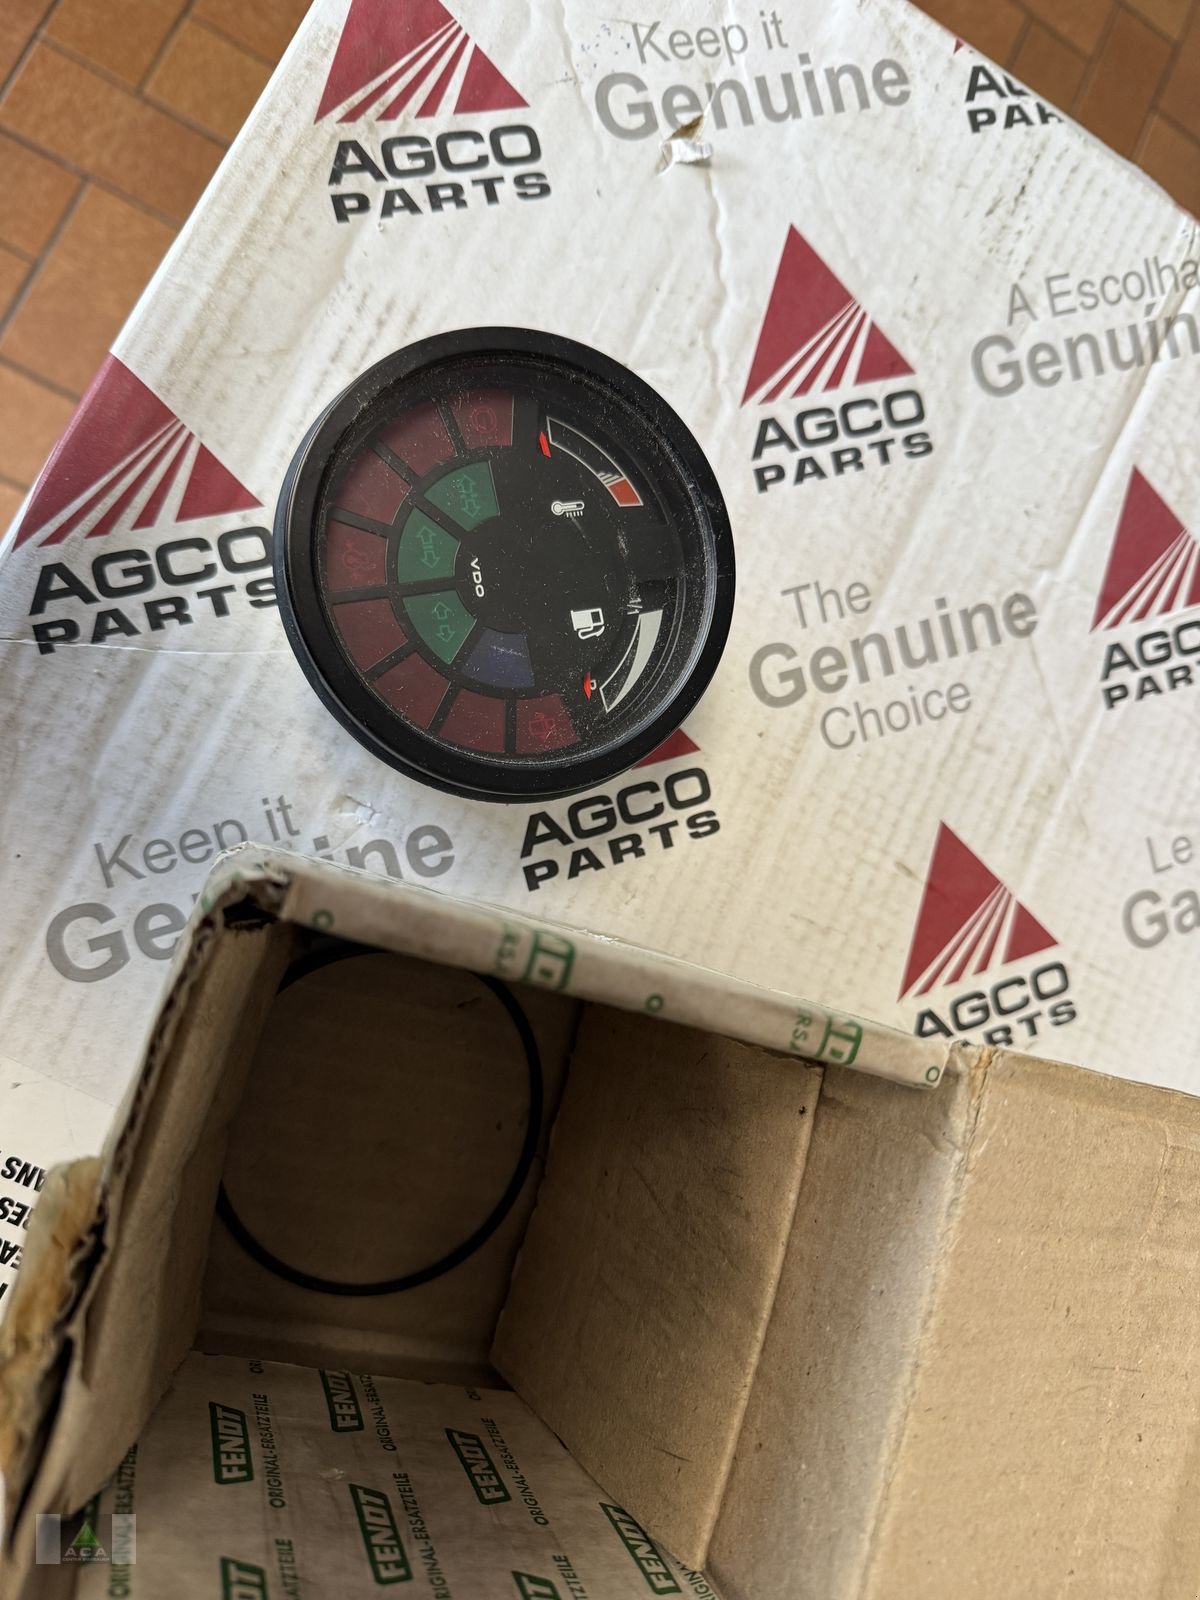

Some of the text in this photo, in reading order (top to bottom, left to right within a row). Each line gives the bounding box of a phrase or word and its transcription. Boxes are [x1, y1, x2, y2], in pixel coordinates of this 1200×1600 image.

[631, 10, 790, 66] Keep it
[594, 52, 913, 142] Genuine
[328, 124, 542, 187] AGCO
[331, 171, 552, 224] PARTS
[1006, 254, 1200, 327] A Escolha
[751, 389, 926, 461] AGCO
[753, 431, 934, 494] PARTS
[28, 526, 273, 617] AGCO
[469, 556, 485, 598] VDO
[781, 579, 873, 630] The
[32, 576, 278, 656] PARTS
[748, 592, 1039, 710] Genuine
[819, 681, 972, 750] Choice
[1102, 660, 1200, 710] PAR
[260, 795, 301, 842] it
[520, 767, 711, 860] AGCO
[522, 810, 721, 892] PARTS
[1146, 834, 1194, 875] Le
[914, 960, 1070, 1039] AGCO
[218, 1404, 250, 1481] FENDT
[251, 1392, 287, 1509] ORIGINAL-ERSATZTEILE
[452, 1431, 506, 1500] FENDT
[480, 1417, 549, 1526] ORIGINAL-ERSATZTEILE
[357, 1487, 408, 1579] FENDT
[606, 1505, 676, 1590] FENDT
